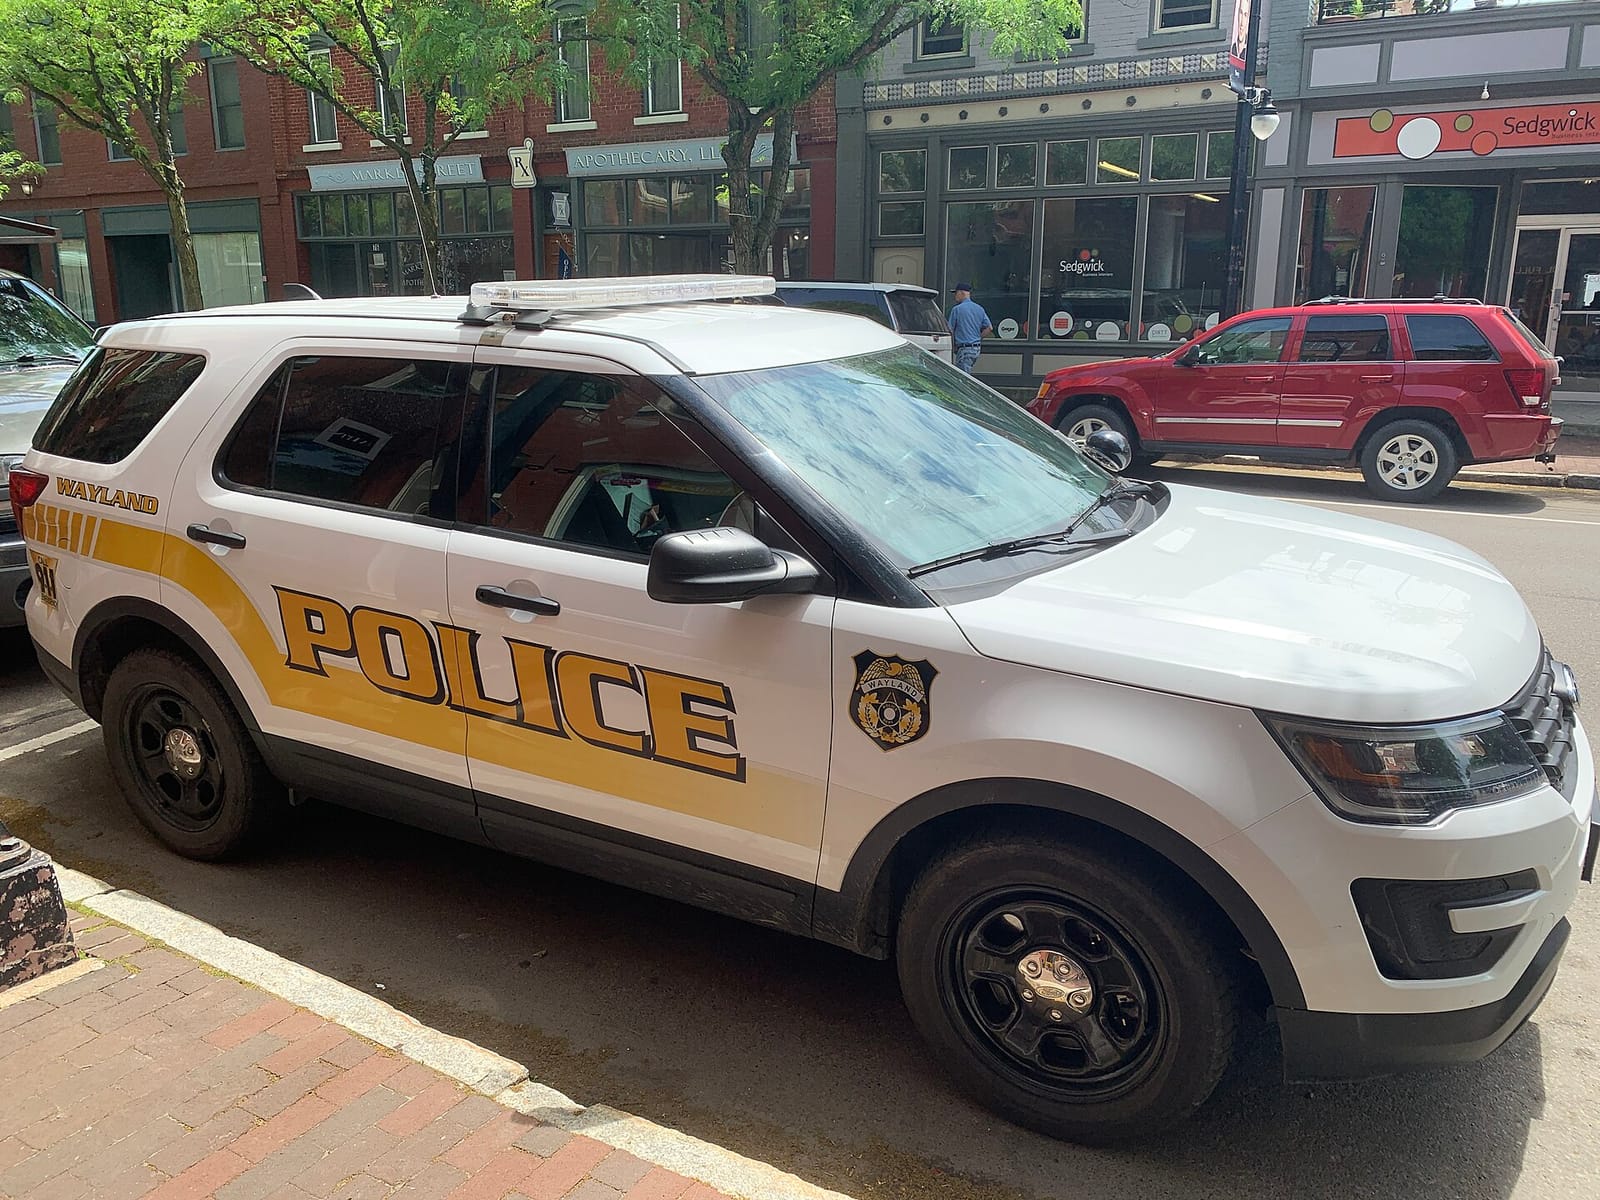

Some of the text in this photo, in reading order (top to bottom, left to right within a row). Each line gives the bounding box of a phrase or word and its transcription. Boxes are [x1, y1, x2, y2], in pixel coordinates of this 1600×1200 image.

[1502, 109, 1596, 137] Sedgwick
[574, 146, 722, 169] APOTHECARY, LL
[351, 162, 475, 182] MARKE SREET
[1059, 258, 1105, 274] Sedgwick
[56, 476, 159, 515] WAYLAND
[35, 562, 57, 600] 911
[272, 584, 747, 783] POLICE
[868, 679, 918, 698] WAYLAND
